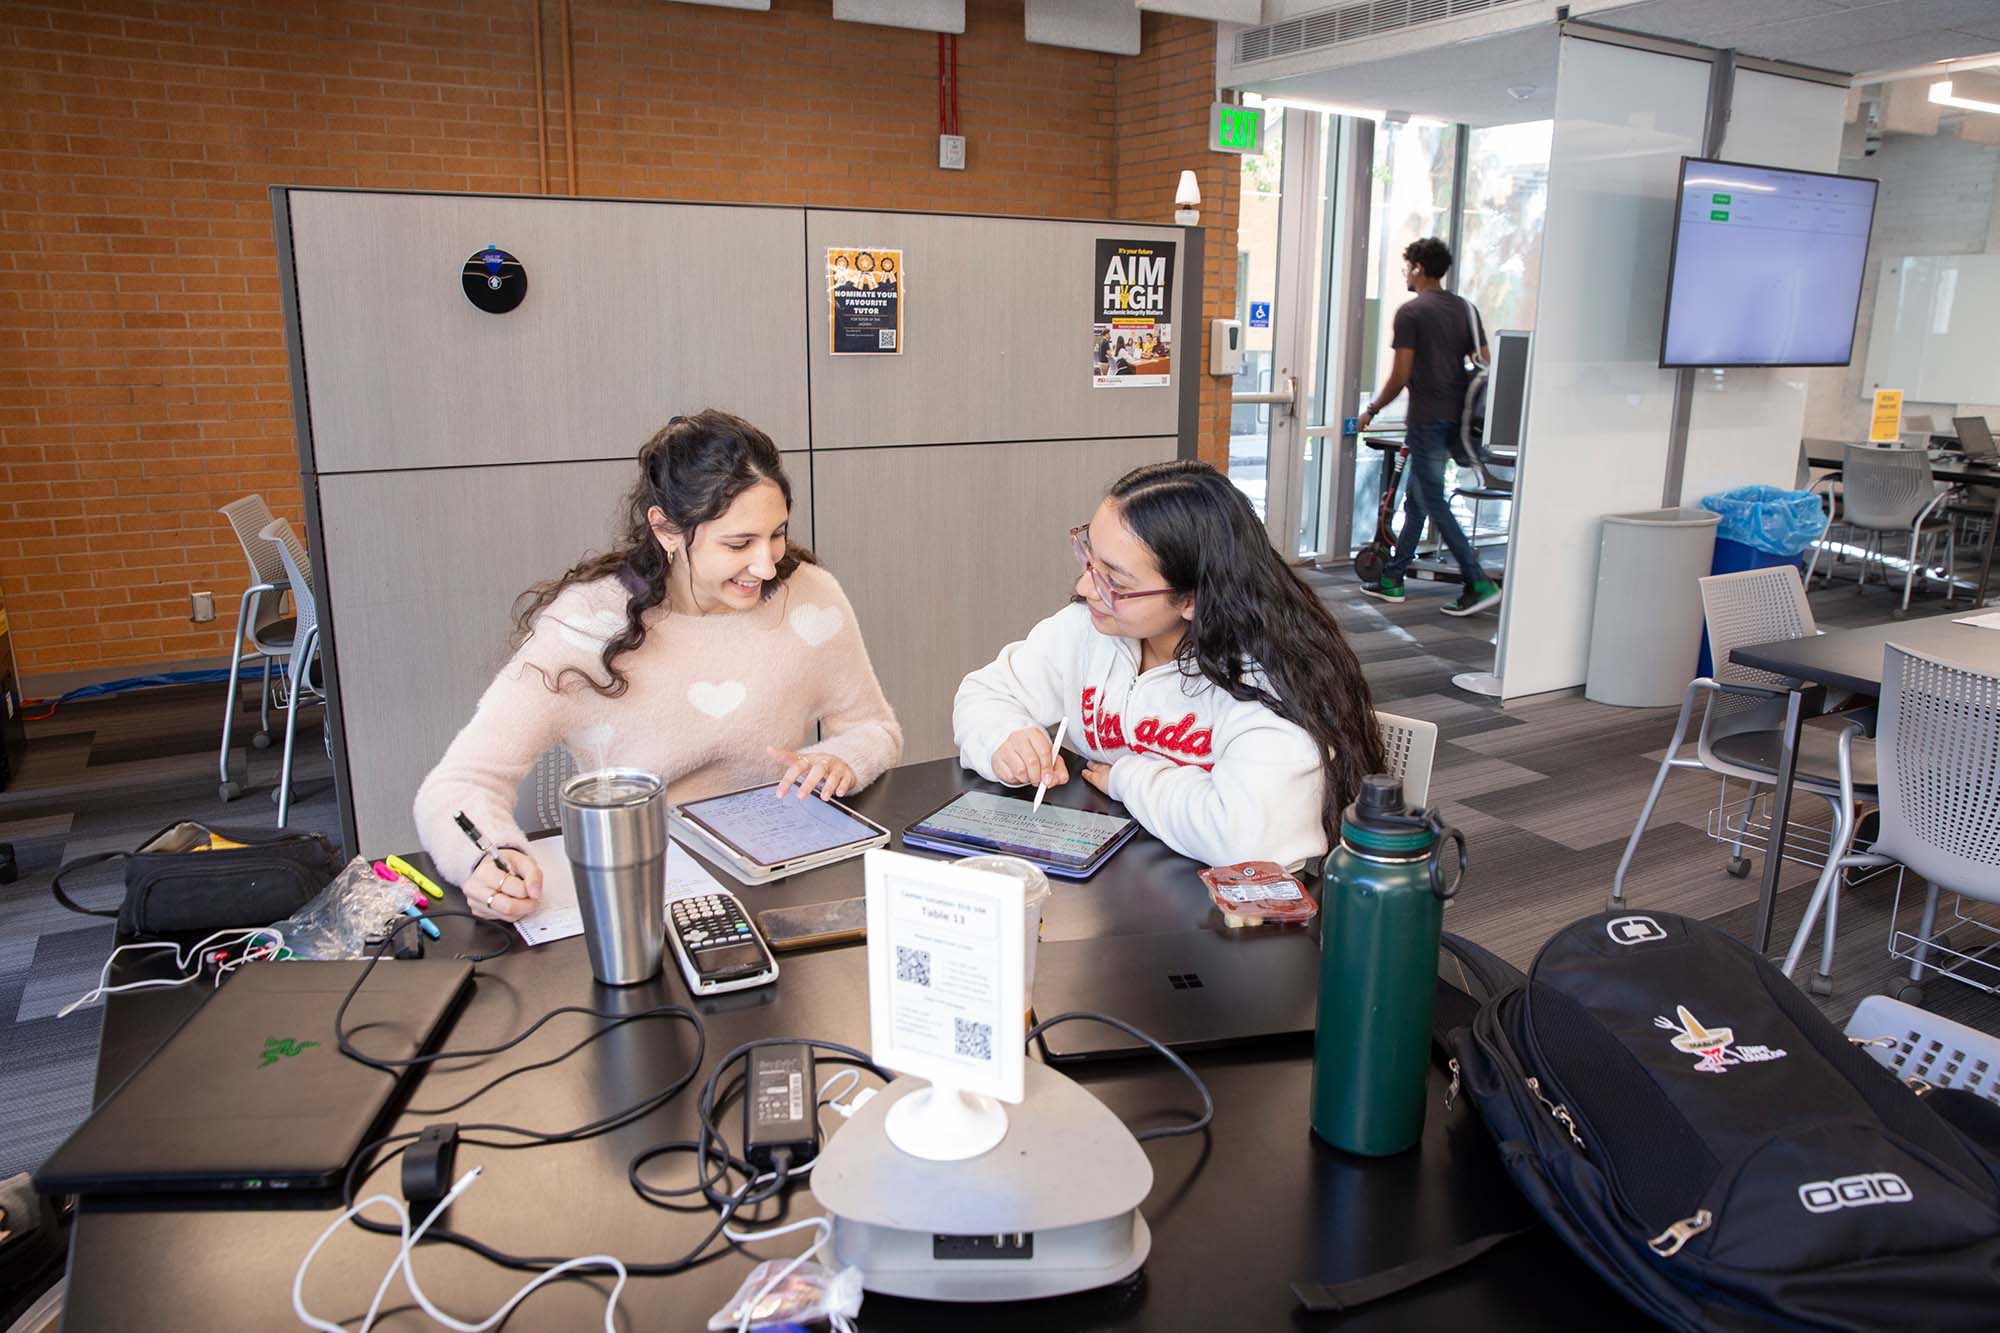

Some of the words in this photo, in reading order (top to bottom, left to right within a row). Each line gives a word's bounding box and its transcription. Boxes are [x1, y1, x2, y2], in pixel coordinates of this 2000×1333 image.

[1220, 109, 1258, 149] EXIT
[922, 906, 950, 920] Table
[1800, 1174, 1910, 1210] OGIO
